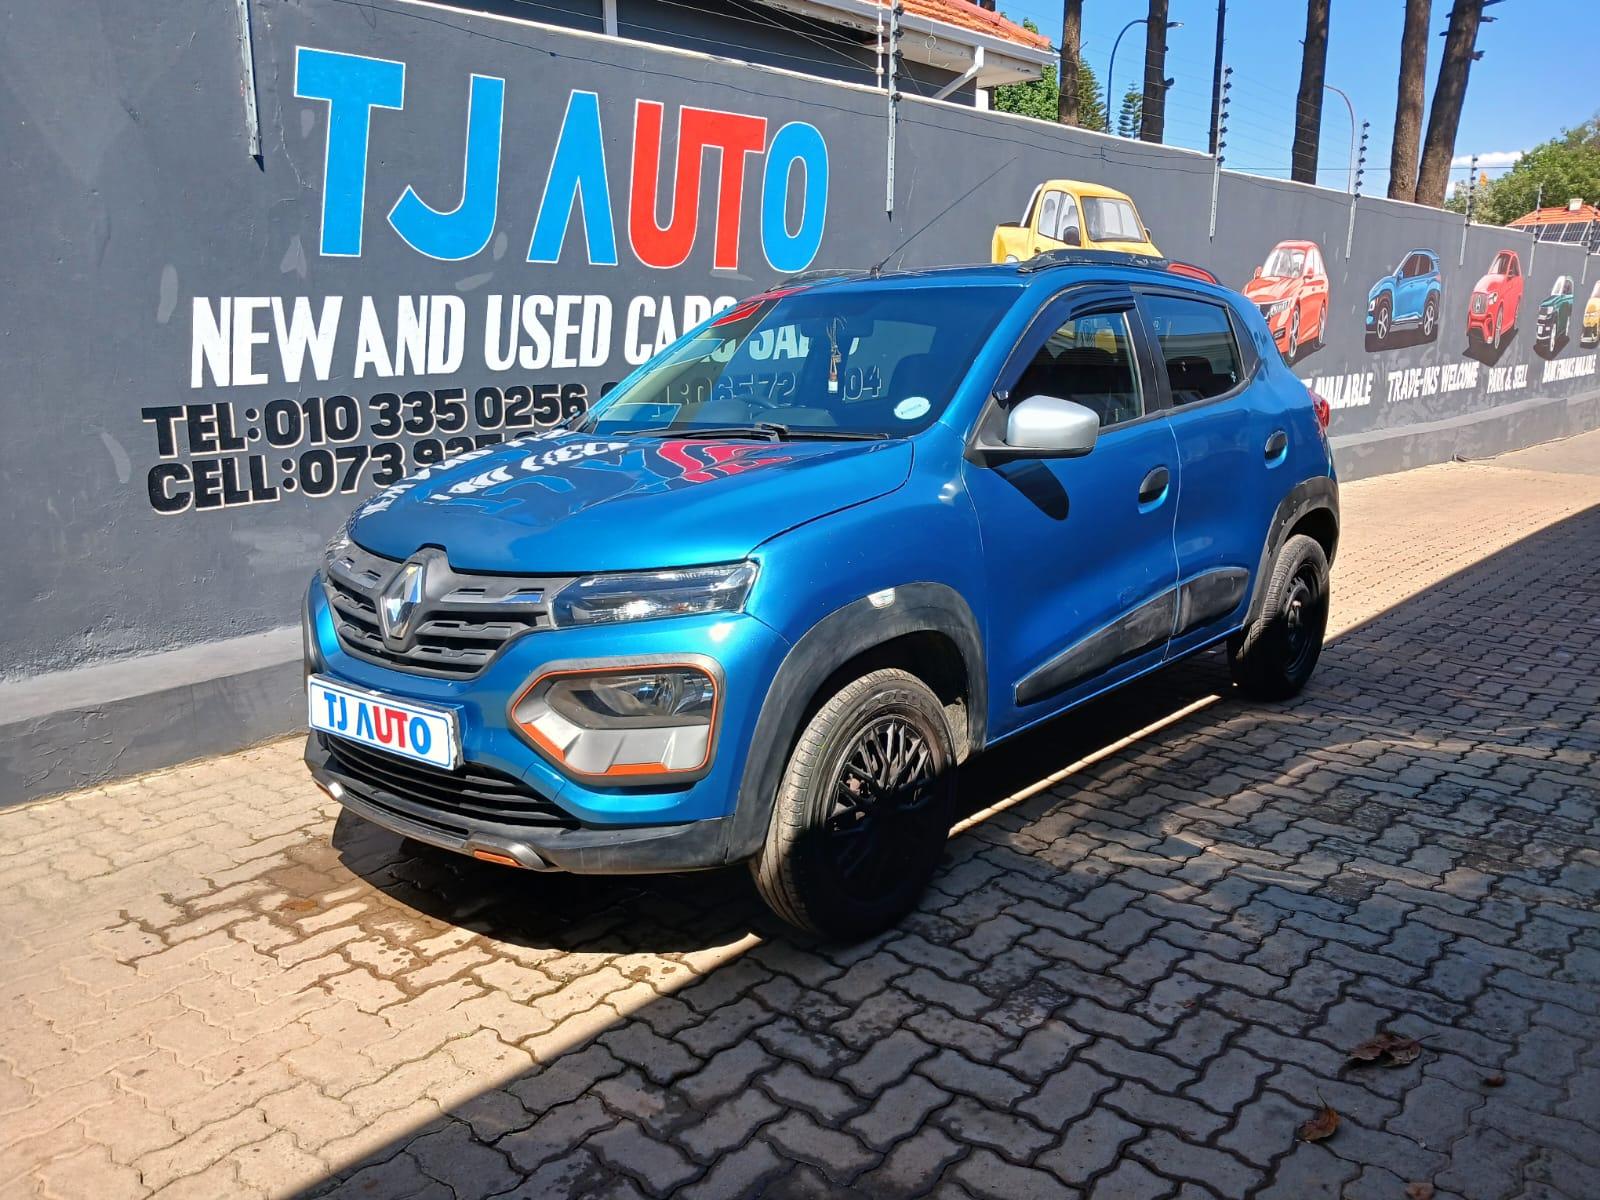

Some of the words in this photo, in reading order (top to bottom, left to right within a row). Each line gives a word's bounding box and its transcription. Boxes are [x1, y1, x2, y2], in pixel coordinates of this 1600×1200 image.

[293, 45, 505, 260] TJ
[526, 89, 829, 273] AUTO
[191, 296, 343, 388] NEW
[354, 295, 466, 378] AND
[485, 294, 613, 371] USED
[1387, 365, 1440, 403] TRADE-INS
[1440, 361, 1480, 393] WELCOME
[1513, 364, 1529, 389] SELL
[369, 388, 468, 438] 335
[474, 383, 590, 430] 0256
[324, 691, 348, 731] TJ
[356, 702, 432, 755] AUTO
